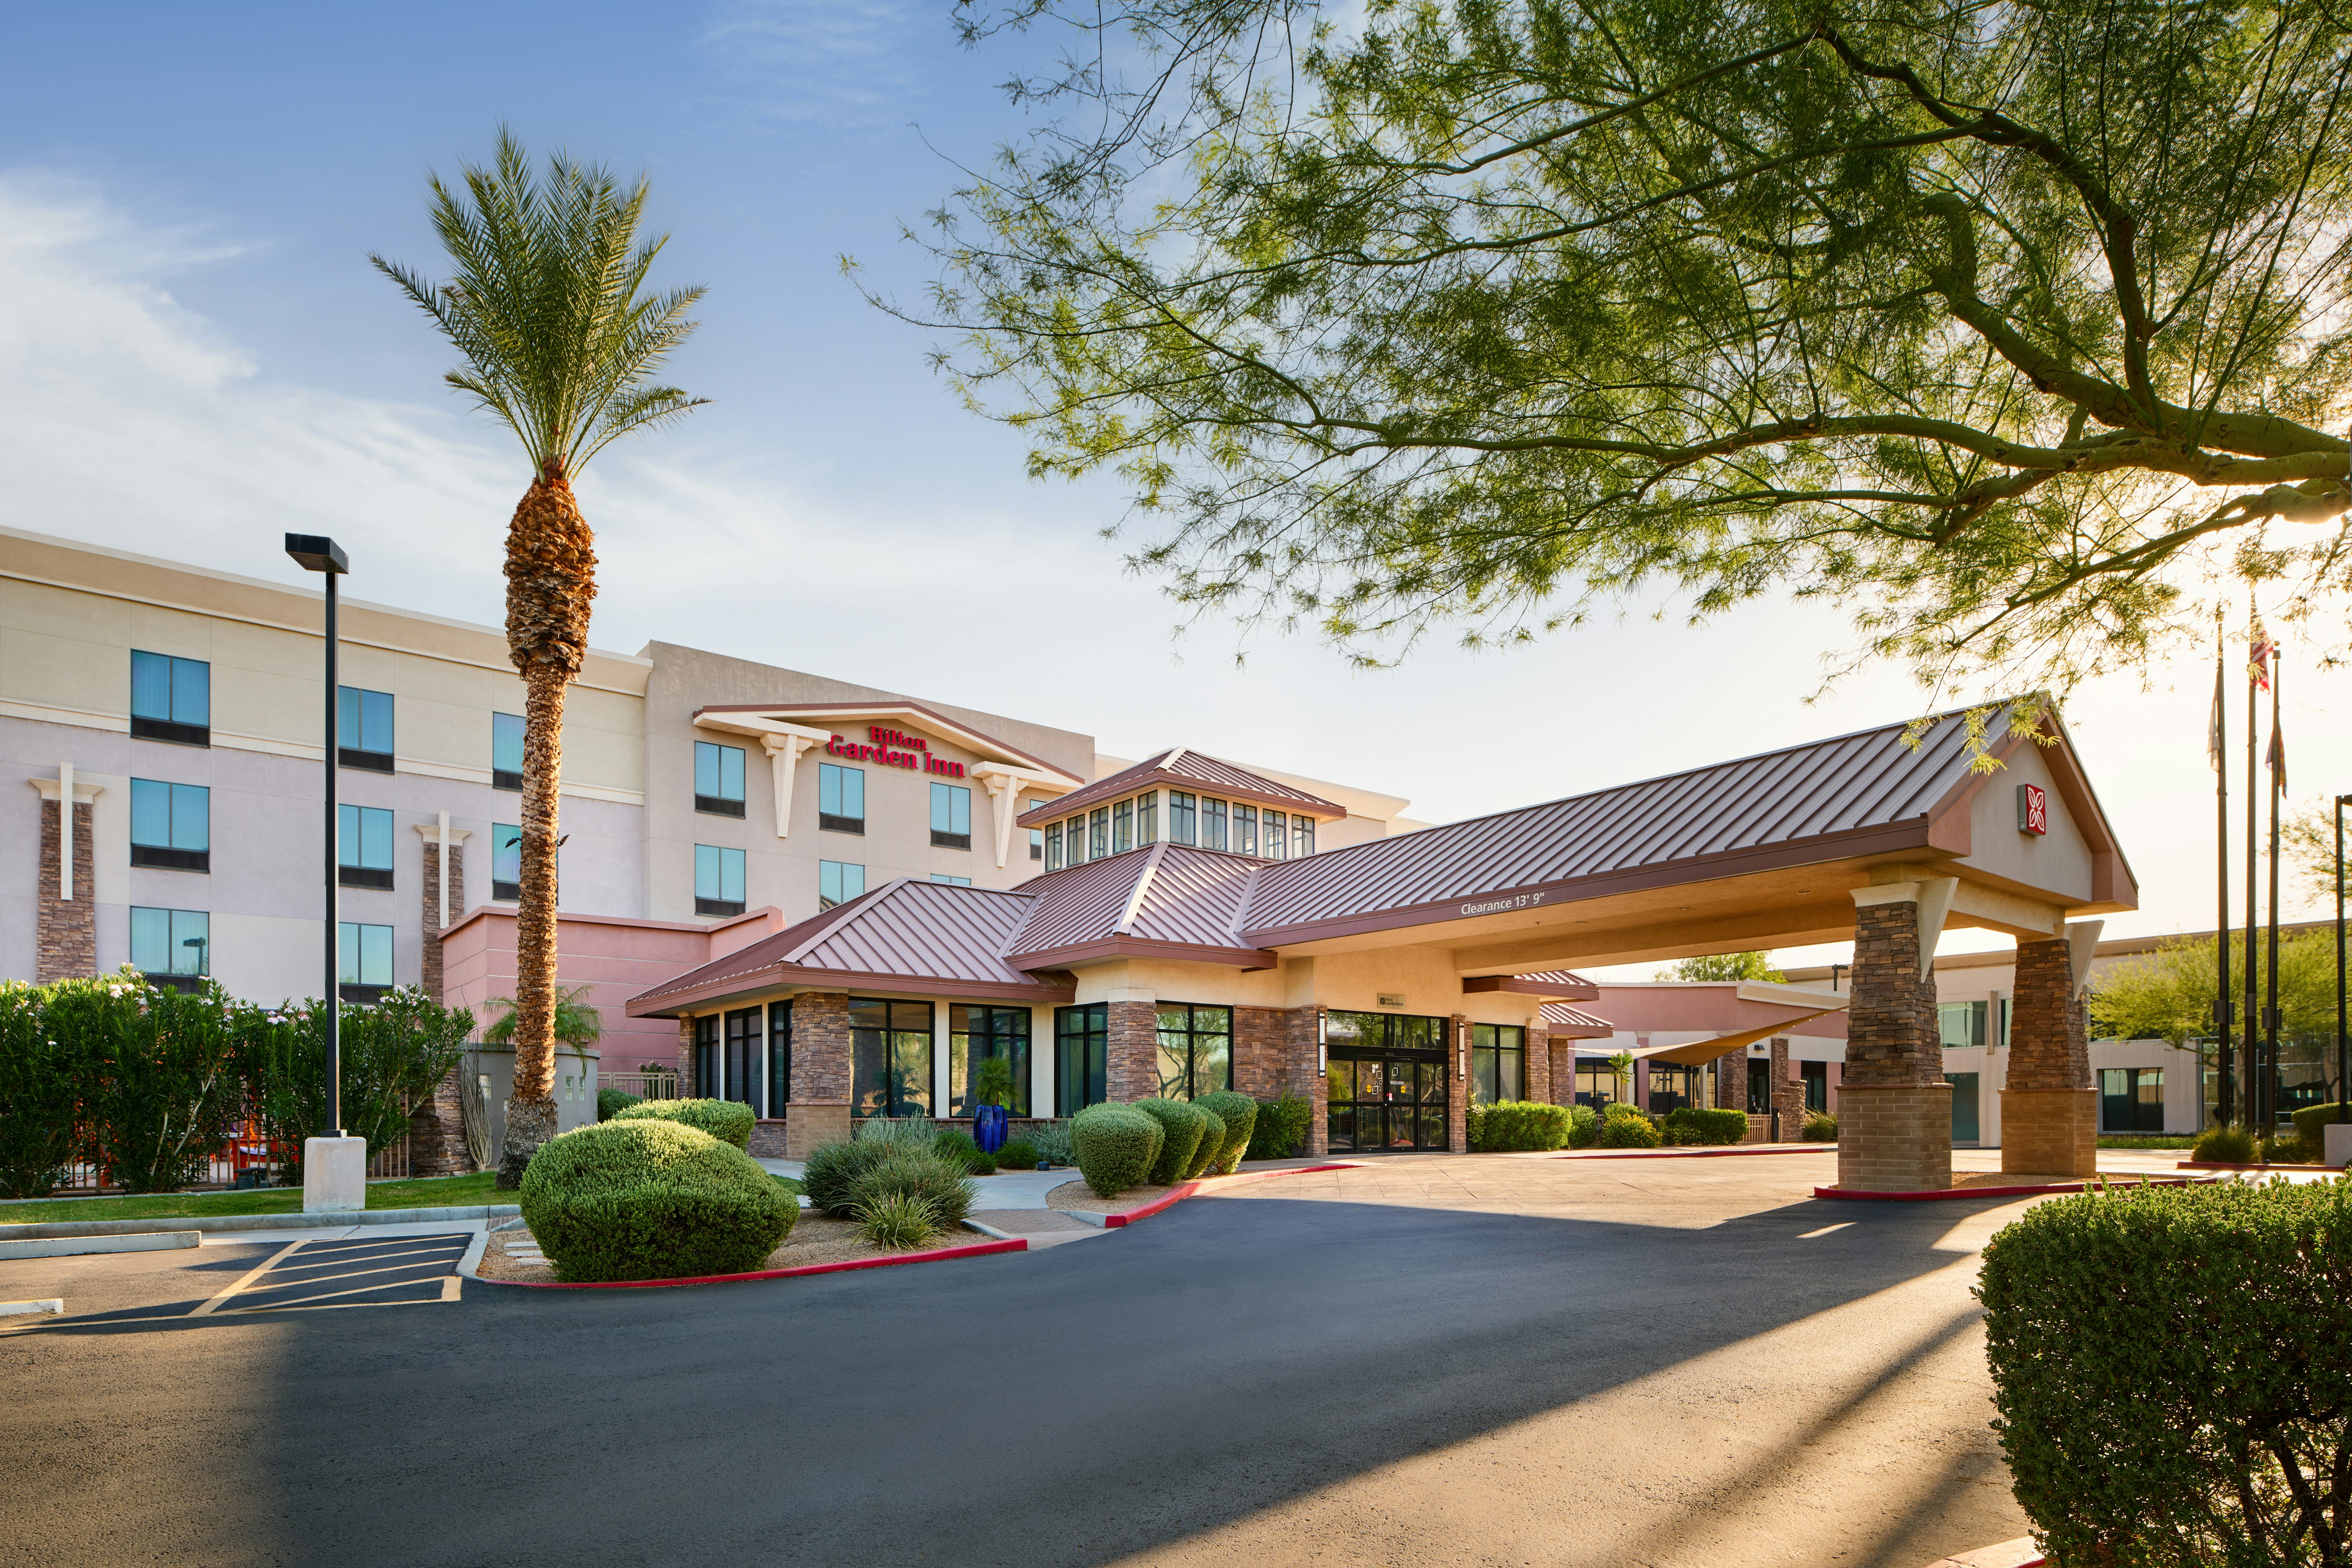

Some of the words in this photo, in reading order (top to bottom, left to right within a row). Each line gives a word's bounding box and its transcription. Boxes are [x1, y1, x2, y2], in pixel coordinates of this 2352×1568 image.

[868, 725, 927, 751] Hilton
[827, 734, 918, 769] Garden
[923, 751, 965, 778] Inn
[1461, 899, 1512, 915] Clearance
[1515, 894, 1529, 907] 13'
[1533, 892, 1545, 904] 9"
